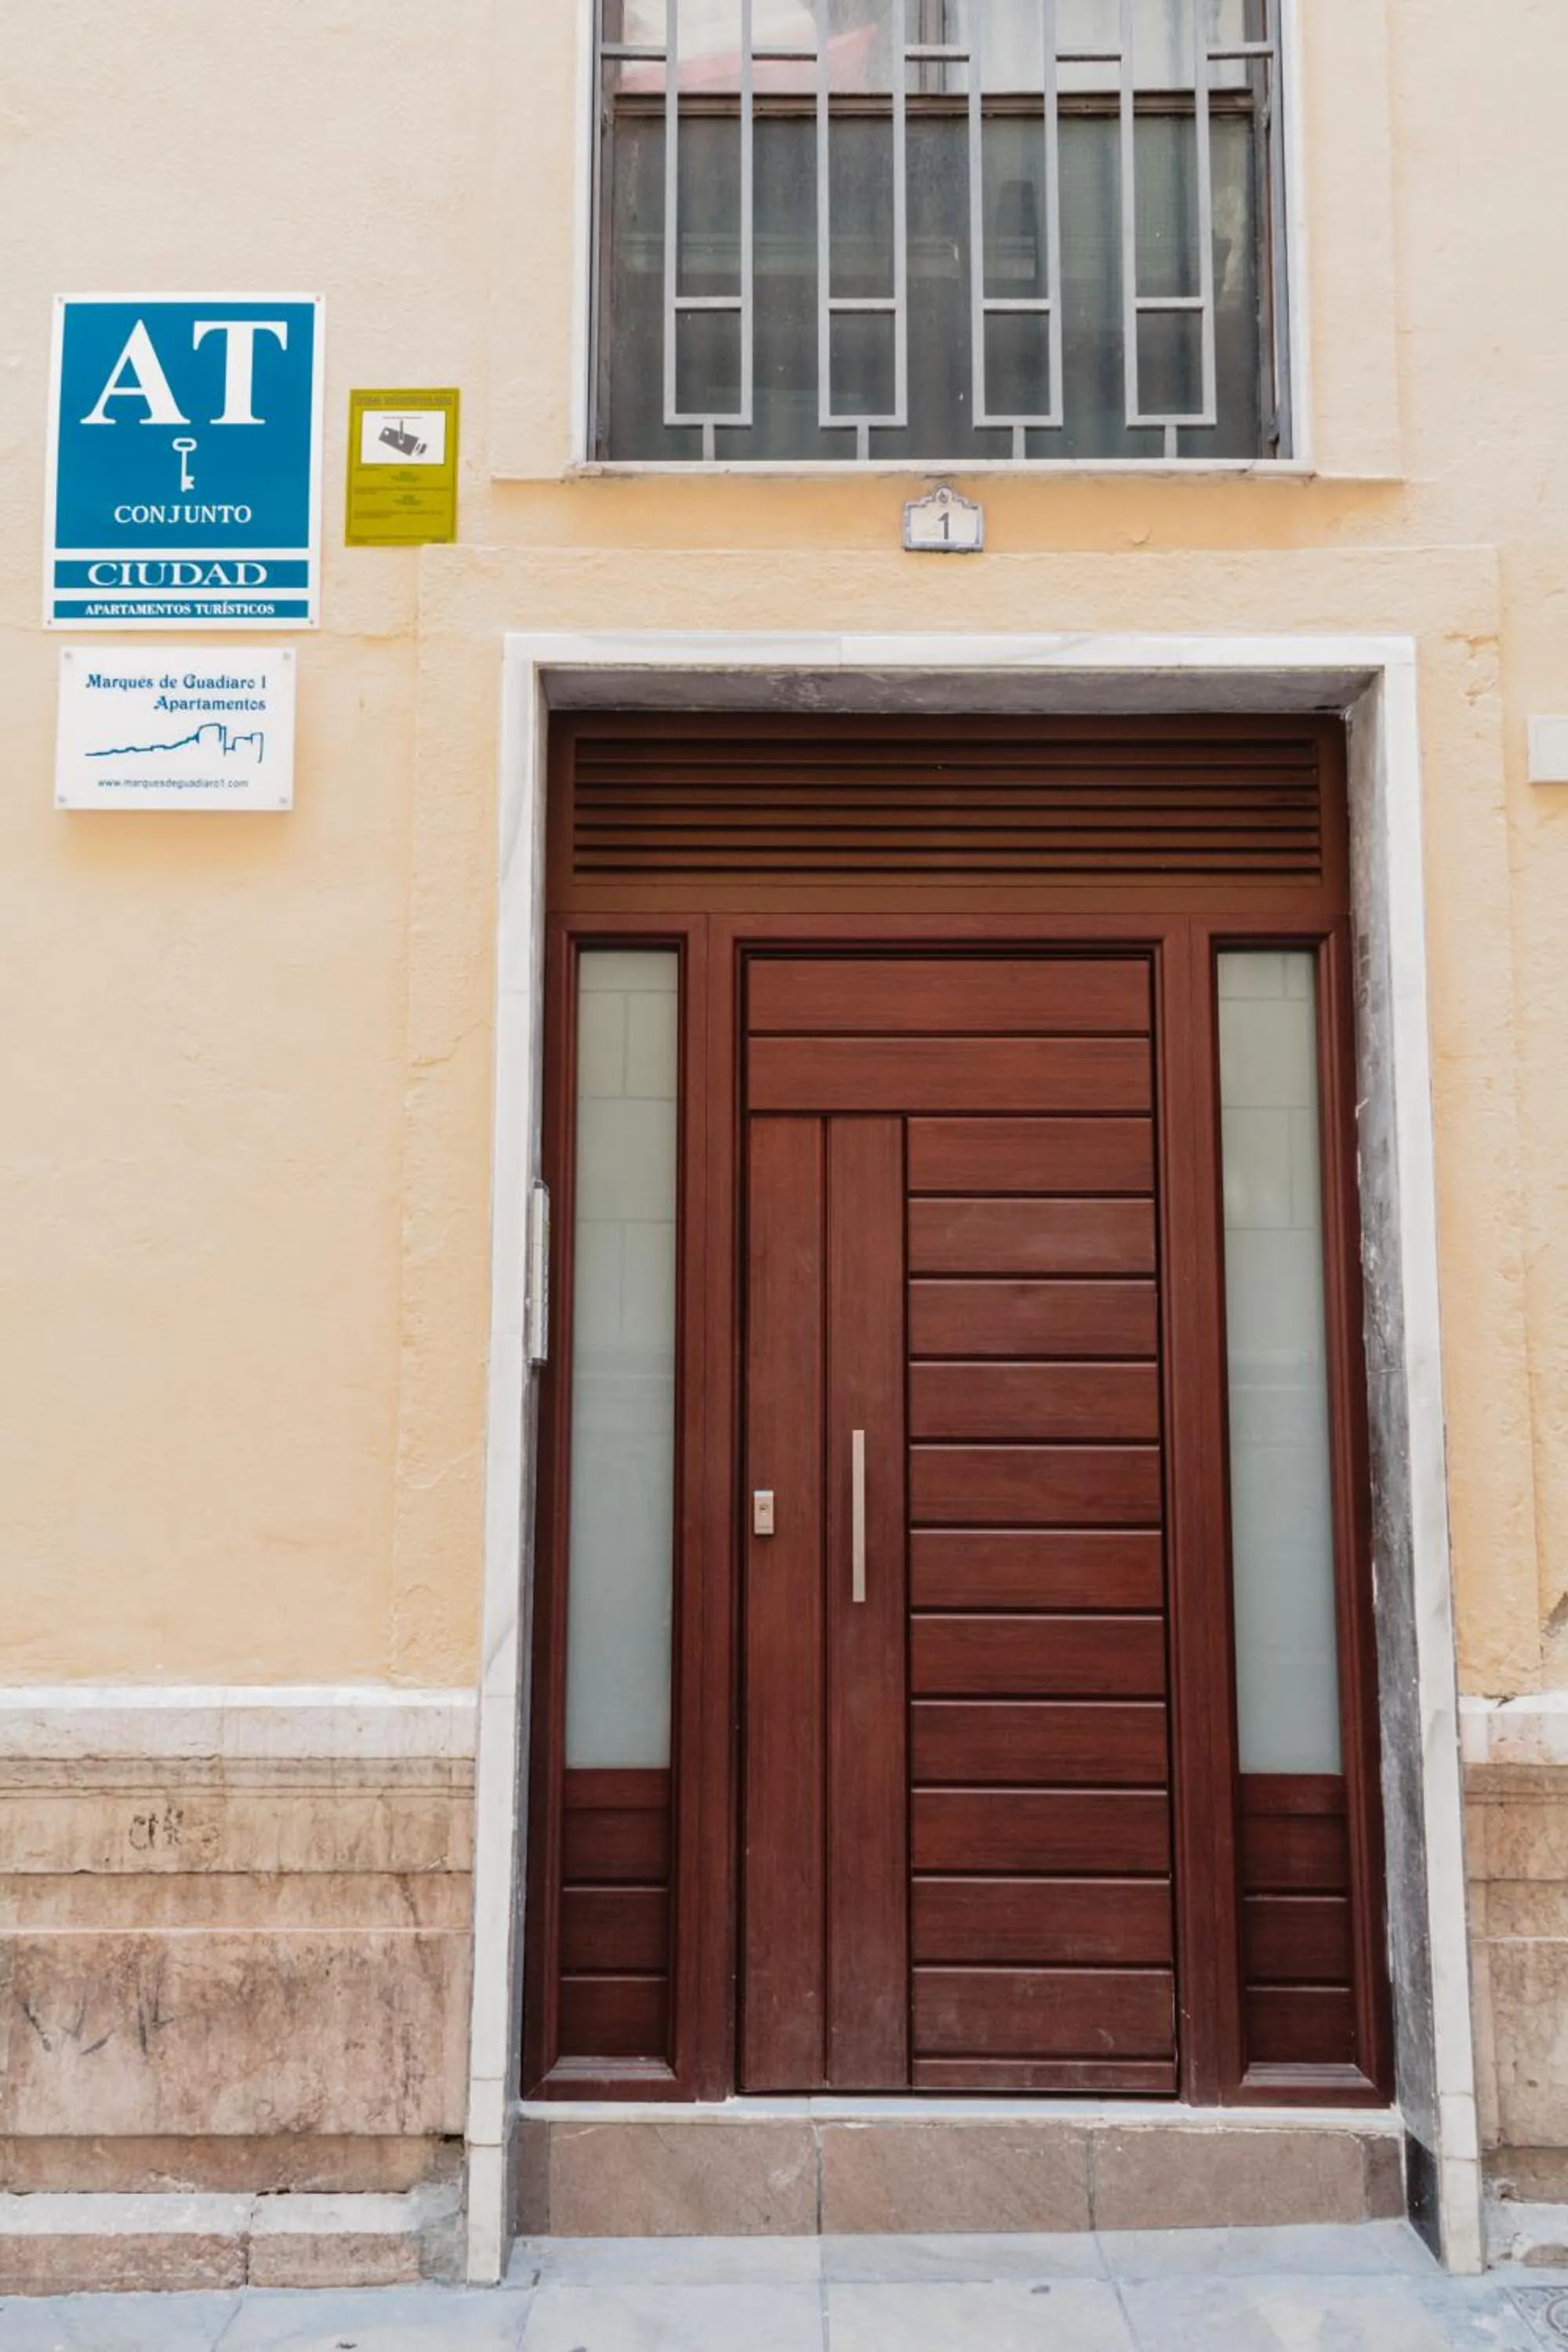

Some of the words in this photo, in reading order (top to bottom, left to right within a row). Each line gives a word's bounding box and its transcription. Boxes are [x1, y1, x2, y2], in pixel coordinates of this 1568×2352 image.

[80, 319, 288, 424] AT
[114, 505, 252, 524] CONJUNTO
[937, 512, 949, 540] 1
[88, 562, 268, 586] CIUDAD
[85, 604, 191, 615] APARTAMENTOS
[194, 601, 275, 615] TURÍSTICOS
[159, 673, 177, 689] de
[183, 673, 256, 690] Guadiaro
[154, 695, 267, 713] Apartamentos
[97, 778, 249, 789] www.marquesdeguadiaro1.com
